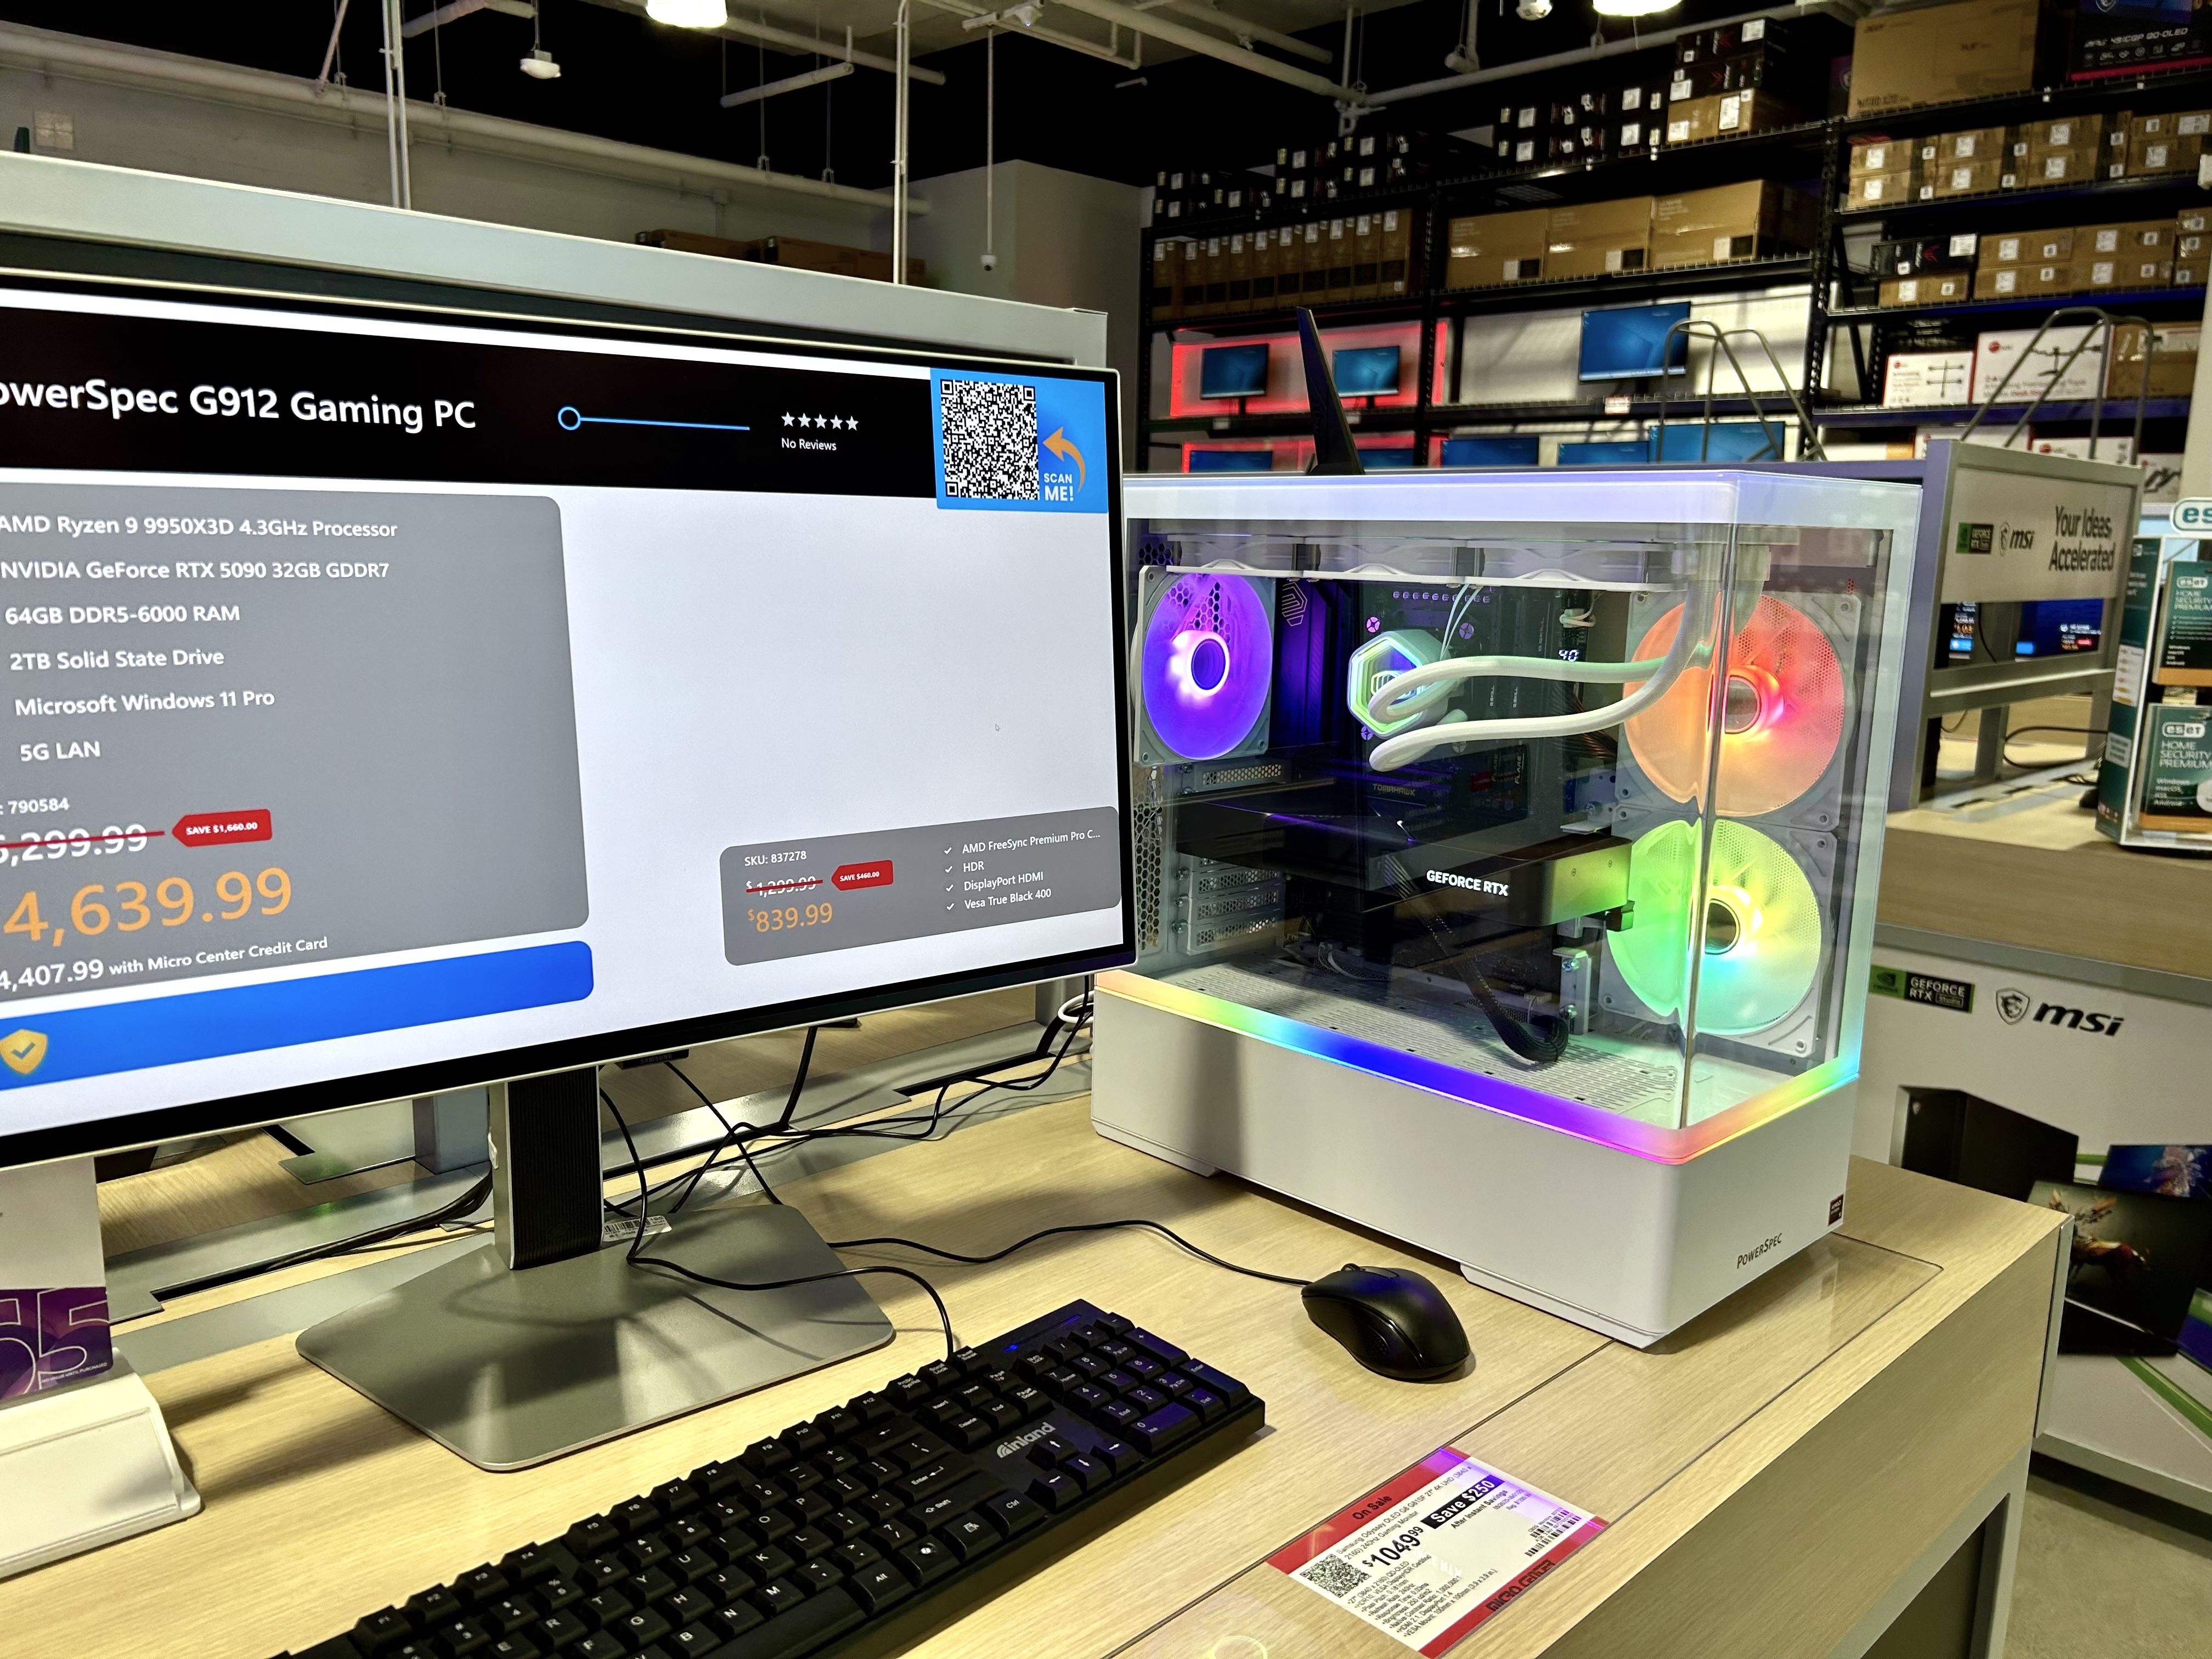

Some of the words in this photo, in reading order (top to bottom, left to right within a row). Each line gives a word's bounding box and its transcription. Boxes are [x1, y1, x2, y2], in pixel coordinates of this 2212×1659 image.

[190, 386, 280, 419] G912
[290, 391, 424, 433] Gaming
[434, 400, 477, 429] PC
[781, 437, 797, 450] No
[799, 438, 837, 452] Reviews
[1043, 472, 1073, 484] SCAN
[1044, 486, 1075, 503] ME!
[0, 515, 50, 533] AMD
[57, 516, 119, 538] Ryzen
[126, 517, 138, 535] 9
[144, 517, 234, 537] 9950X3D
[239, 520, 308, 537] 4.3GHz
[313, 521, 398, 538] Processor
[2056, 505, 2081, 537] Your
[2009, 528, 2036, 550] msi
[0, 561, 81, 579] NVIDIA
[86, 561, 170, 579] GeForce
[176, 562, 215, 579] RTX
[220, 562, 267, 579] 5090
[272, 562, 321, 578] 32GB
[326, 562, 390, 579] GDDR7
[5, 607, 63, 625] 64GB
[69, 606, 188, 624] DDR5-6000
[193, 605, 240, 622] RAM
[10, 653, 50, 671] 2TB
[57, 651, 109, 669] Solid
[116, 650, 167, 668] State
[173, 648, 225, 666] Drive
[15, 694, 117, 716] Microsoft
[122, 692, 215, 712] Windows
[220, 692, 236, 707] 11
[243, 690, 275, 707] Pro
[20, 743, 50, 762] 5G
[56, 741, 101, 760] LAN
[2160, 751, 2212, 759] SECURITY
[2162, 741, 2197, 751] HOME
[2159, 759, 2212, 769] PREMIUM
[1373, 783, 1415, 797] TOMAHAWK
[8, 798, 70, 815] 790584
[185, 825, 211, 836] SAVE
[962, 842, 986, 854] AMD
[988, 838, 1028, 851] FreeSync
[1030, 833, 1068, 845] Premium
[1071, 831, 1085, 841] Pro
[744, 856, 769, 866] SKU:
[771, 850, 807, 864] 837278
[963, 861, 985, 873] HDR
[856, 871, 879, 879] $460.00
[964, 875, 1016, 891] DisplayPort
[1018, 871, 1043, 883] HDMI
[1426, 870, 1481, 891] GEFORCE
[1483, 881, 1509, 896] RTX
[3, 867, 292, 947] 4,639.99
[964, 899, 986, 910] Vesa
[988, 896, 1008, 906] True
[1010, 891, 1033, 903] Black
[1035, 888, 1052, 899] 400
[109, 958, 144, 975] with
[148, 953, 192, 971] Micro
[196, 946, 245, 966] Center
[249, 940, 292, 958] Credit
[296, 936, 328, 954] Card
[1909, 989, 1932, 1001] RTX
[1910, 976, 1965, 997] GEFORCE
[2033, 1002, 2125, 1037] msi
[80, 1362, 108, 1373] PURCHASED
[796, 1427, 809, 1436] F10
[1004, 1422, 1056, 1454] inland
[911, 1475, 928, 1485] Enter
[935, 1499, 951, 1508] Shift
[1006, 1499, 1019, 1509] Ctrl
[1352, 1509, 1372, 1519] On
[1367, 1496, 1392, 1510] Sale
[1431, 1502, 1465, 1522] Save
[1462, 1480, 1494, 1500] $250
[1451, 1517, 1466, 1528] After
[1464, 1504, 1487, 1519] Instant
[1483, 1490, 1508, 1505] Savings
[1336, 1537, 1364, 1554] Samsung
[1361, 1522, 1386, 1537] Odyssey
[1383, 1511, 1401, 1523] OLED
[1440, 1477, 1454, 1486] UHD
[1344, 1548, 1363, 1560] 2160)
[1361, 1537, 1380, 1549] 240Hz
[1378, 1523, 1401, 1537] Gaming
[1397, 1511, 1418, 1524] Monitor
[876, 1573, 889, 1583] Alt
[1386, 1561, 1409, 1577] QD-OLED
[1374, 1584, 1389, 1594] VESA
[1386, 1566, 1414, 1585] DisplayHDR
[1398, 1583, 1415, 1594] 240Hz
[1398, 1621, 1413, 1632] HDMI
[1419, 1596, 1446, 1616] DisplayPort
[1404, 1625, 1421, 1635] VESA
[1434, 1602, 1452, 1614] 100mm
[1453, 1588, 1470, 1600] 100mm
